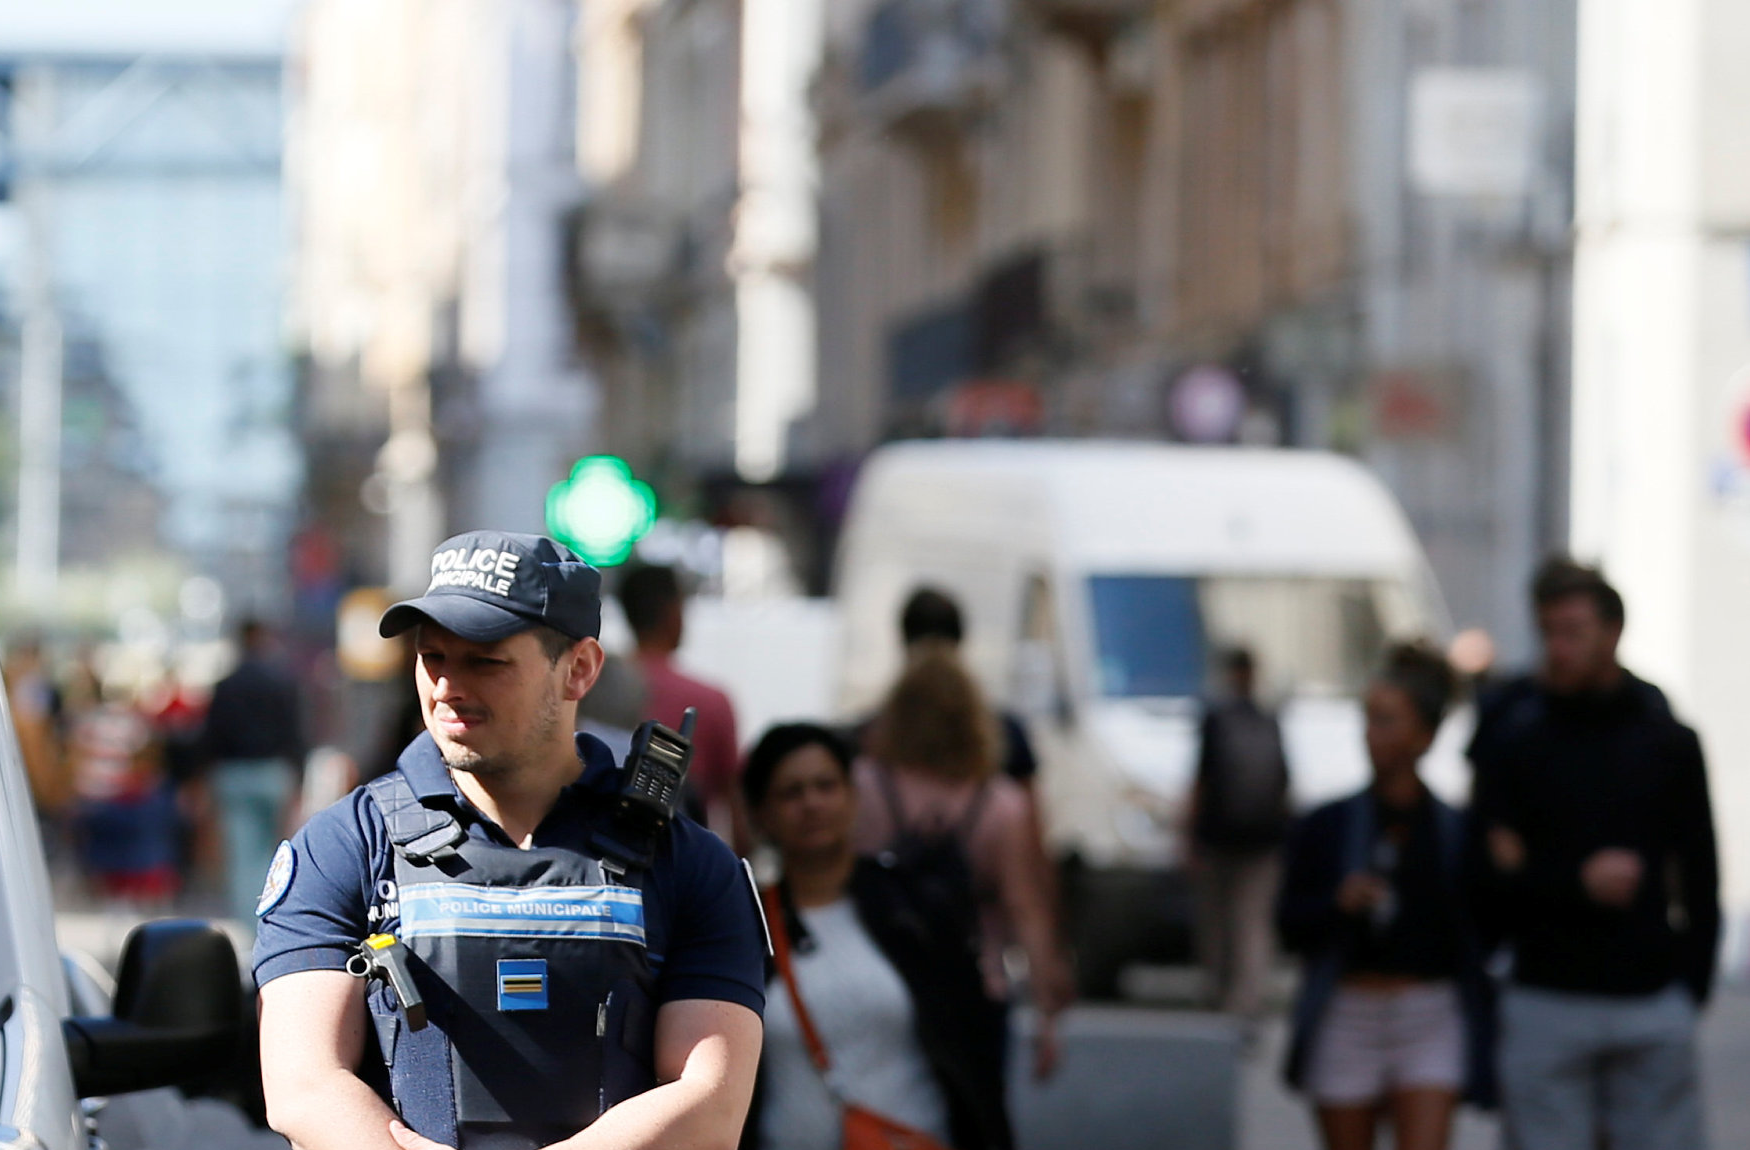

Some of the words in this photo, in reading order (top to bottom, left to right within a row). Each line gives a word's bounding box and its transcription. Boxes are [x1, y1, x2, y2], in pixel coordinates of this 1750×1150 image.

[431, 547, 521, 580] POLICE
[439, 901, 502, 914] POLICE
[507, 902, 611, 917] MUNICIPALE
